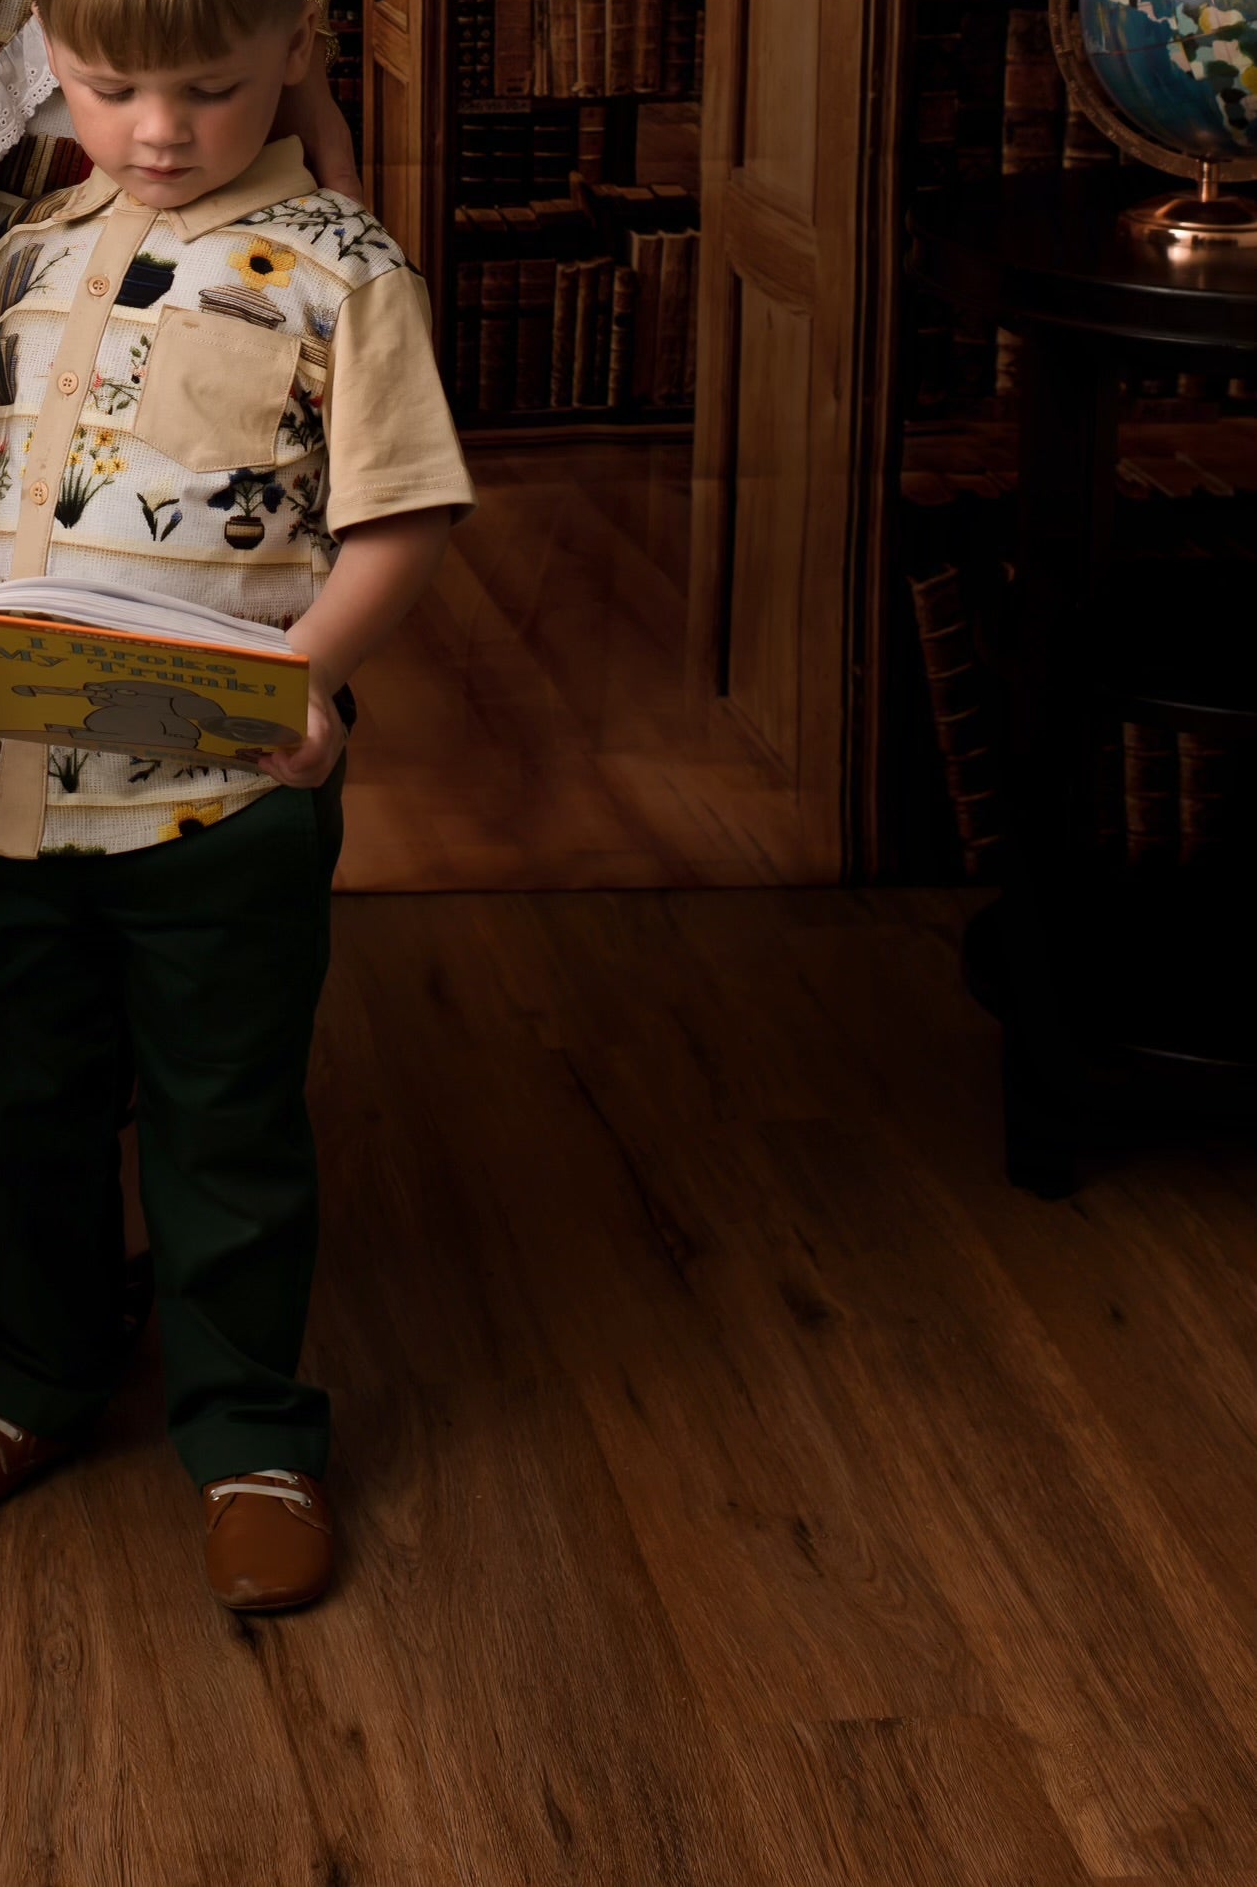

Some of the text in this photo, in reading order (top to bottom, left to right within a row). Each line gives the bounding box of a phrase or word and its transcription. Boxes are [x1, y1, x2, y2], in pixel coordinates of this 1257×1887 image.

[25, 635, 237, 675] I Broke
[86, 657, 277, 697] Trunk!
